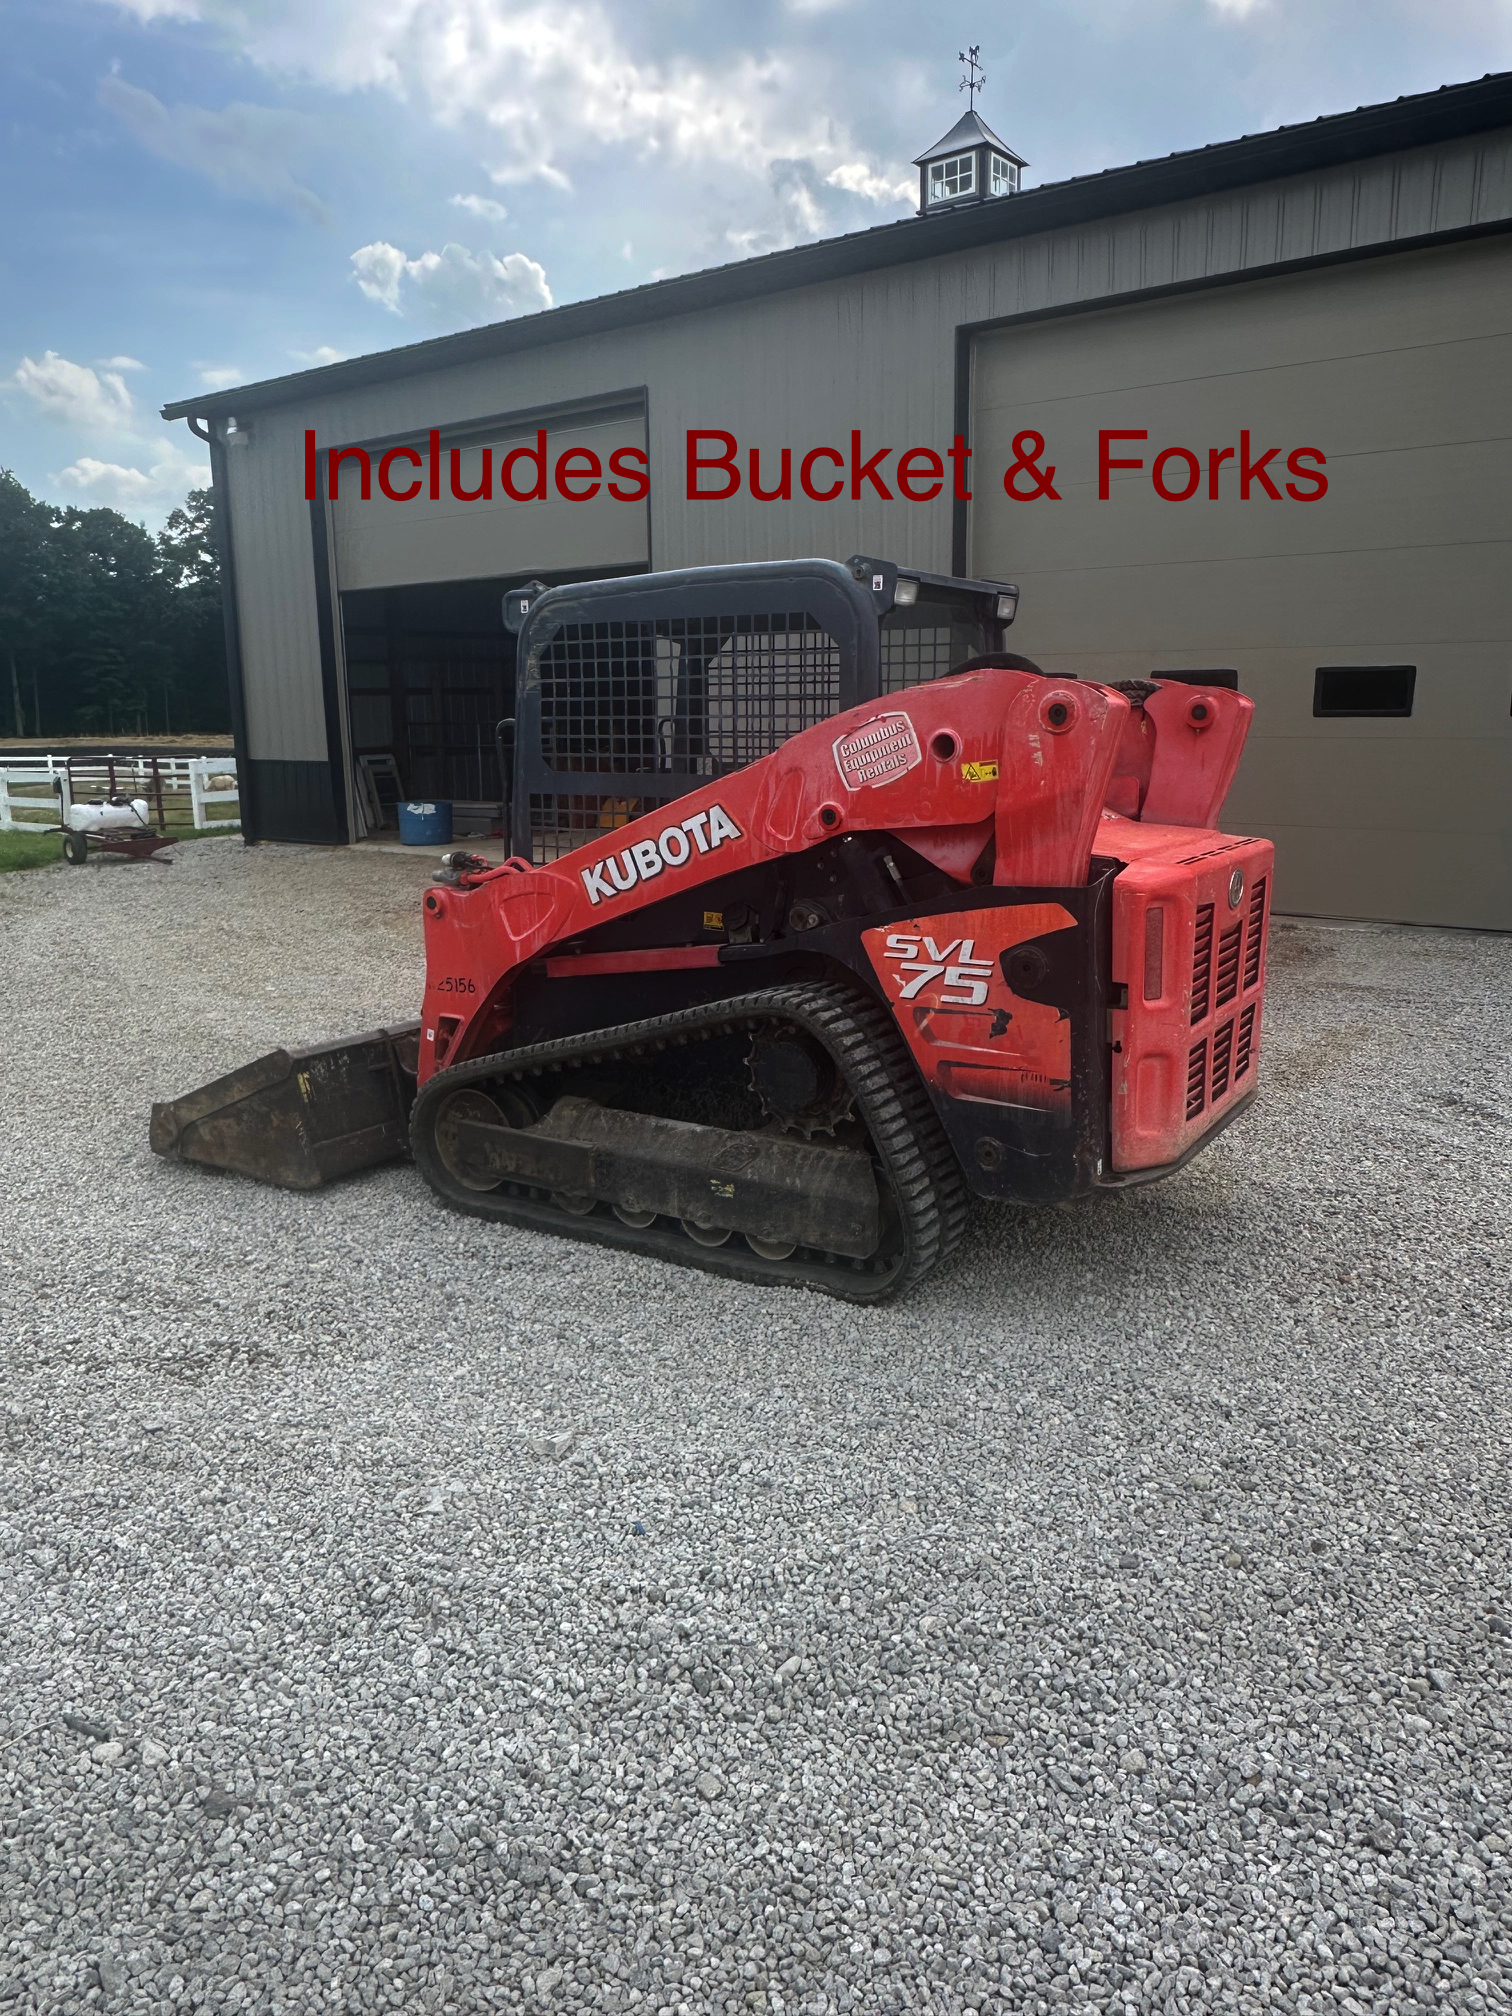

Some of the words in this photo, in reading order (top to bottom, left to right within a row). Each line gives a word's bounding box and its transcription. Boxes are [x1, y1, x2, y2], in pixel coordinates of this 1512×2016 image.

[840, 720, 906, 758] Columbus
[843, 733, 913, 773] Equipment
[857, 753, 908, 783] Rentals
[580, 804, 742, 905] KUBOTA
[882, 933, 995, 967] SVL
[898, 962, 993, 1007] 75
